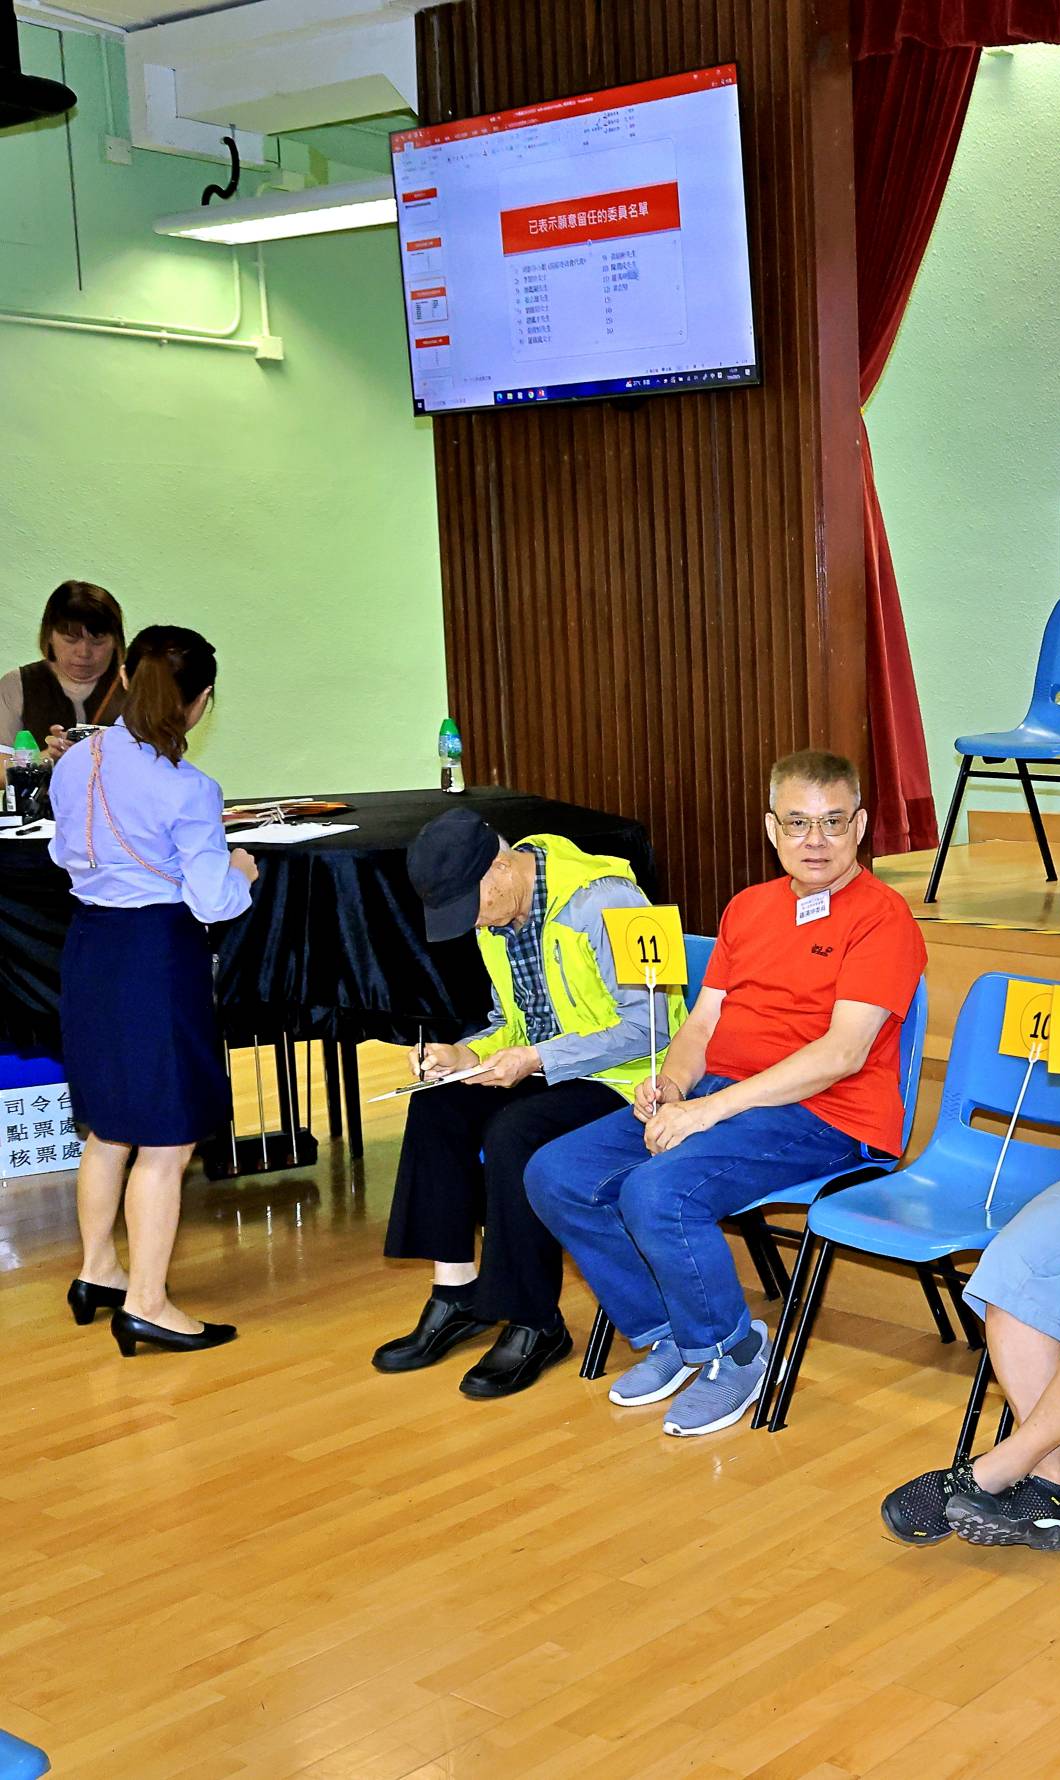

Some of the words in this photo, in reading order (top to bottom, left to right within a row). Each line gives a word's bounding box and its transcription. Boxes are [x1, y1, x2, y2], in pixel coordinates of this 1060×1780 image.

[528, 202, 649, 235] 已表示願意留任的委員名單
[637, 935, 661, 964] 11
[4, 1092, 72, 1116] 司令台
[7, 1117, 78, 1143] 點票處
[9, 1141, 82, 1168] 核票處
